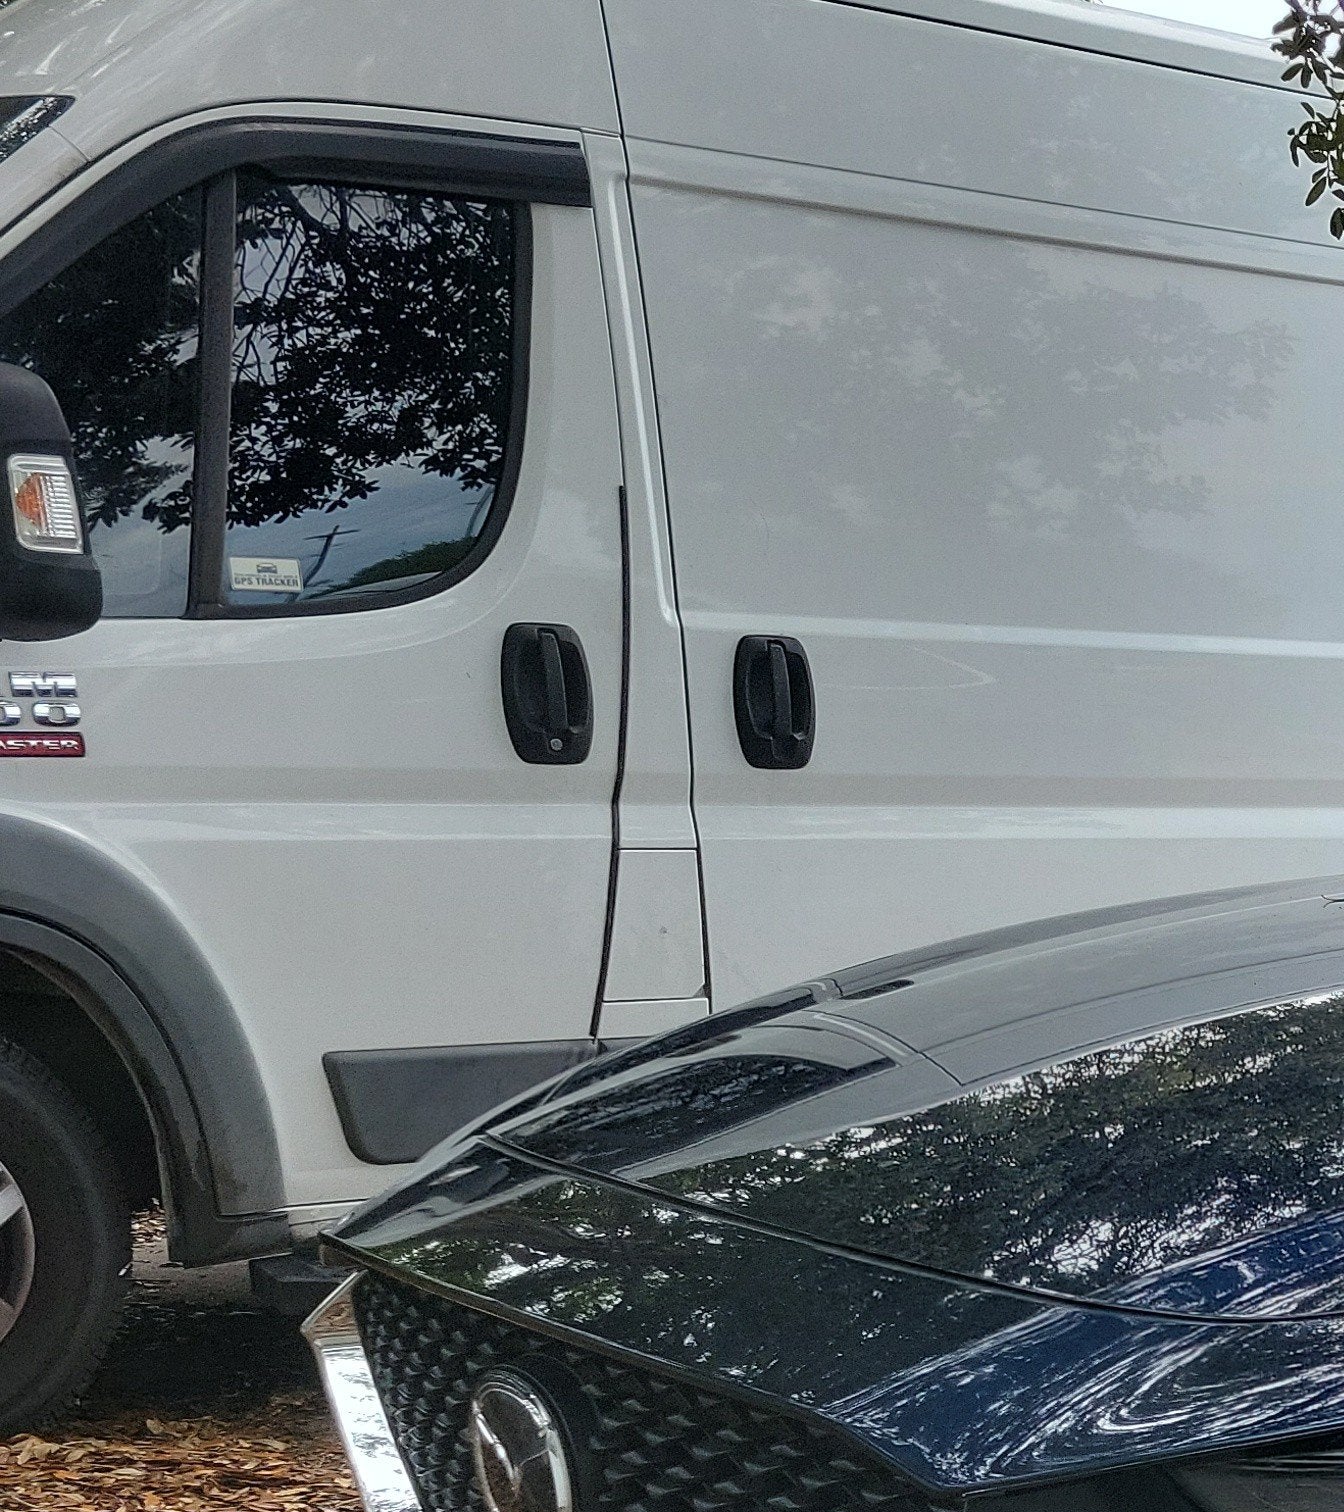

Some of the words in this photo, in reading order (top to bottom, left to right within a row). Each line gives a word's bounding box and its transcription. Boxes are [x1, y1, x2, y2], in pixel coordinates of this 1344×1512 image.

[234, 576, 254, 586] GPS
[256, 577, 299, 588] TRACKER
[0, 671, 78, 698] M
